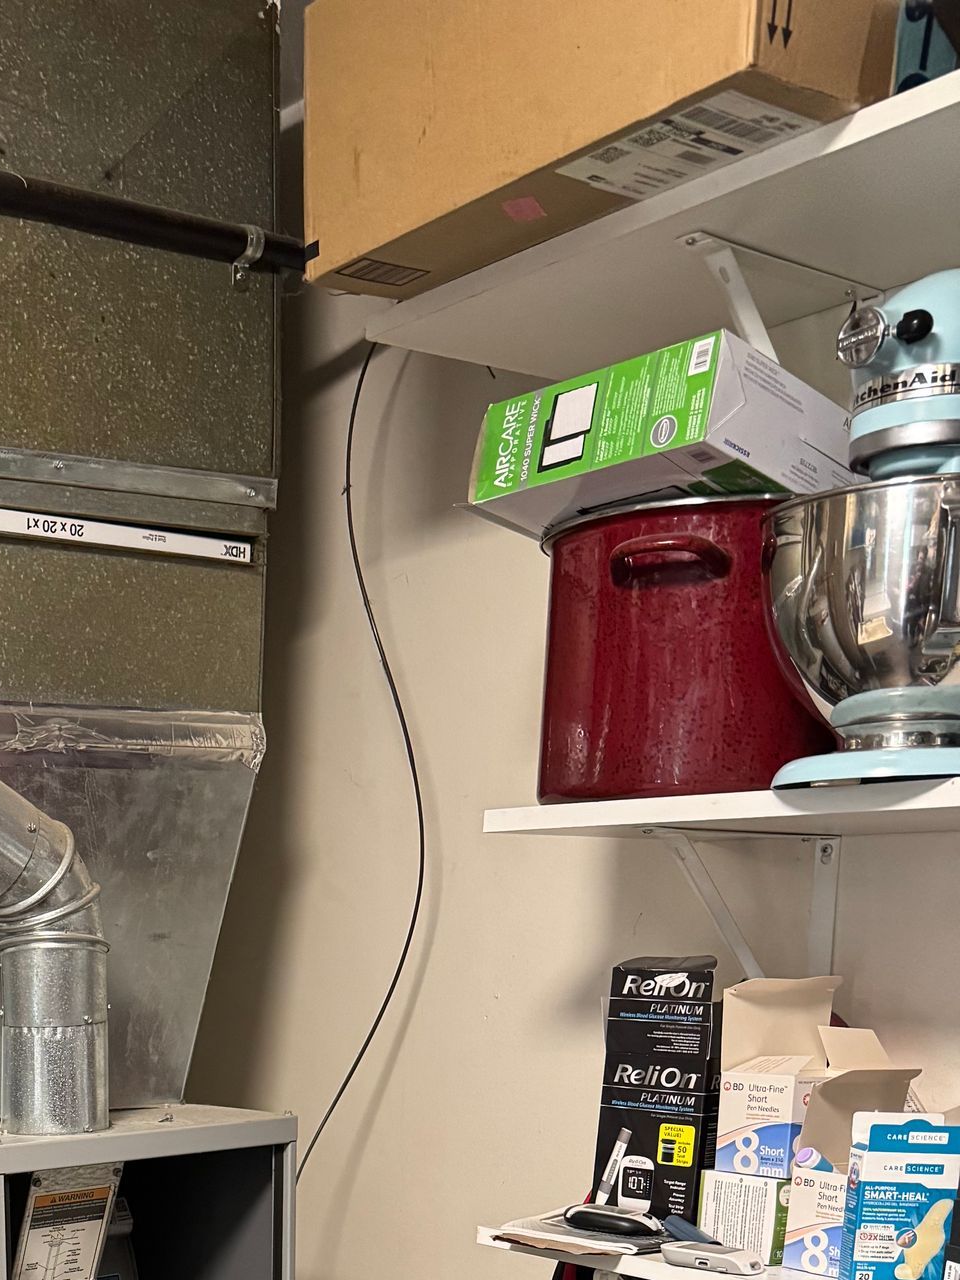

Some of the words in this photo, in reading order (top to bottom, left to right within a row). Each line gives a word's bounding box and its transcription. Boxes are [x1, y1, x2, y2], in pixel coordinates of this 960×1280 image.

[494, 402, 521, 487] AIRCARE
[506, 400, 527, 487] EVAPORATIVE
[524, 424, 535, 457] SUPER
[521, 460, 529, 480] 1040
[42, 520, 57, 534] 20
[60, 522, 67, 532] x
[69, 523, 84, 537] 20
[223, 544, 246, 558] HDX
[650, 1004, 703, 1015] PLATINUM
[614, 1064, 699, 1089] ReliOn
[641, 1093, 695, 1106] PLATINUM
[748, 1094, 767, 1103] Short
[733, 1130, 759, 1173] 8
[760, 1146, 784, 1156] Short
[628, 1177, 643, 1189] 107
[58, 1192, 94, 1201] WARNING
[818, 1192, 838, 1203] Short
[864, 1191, 927, 1201] SMART-HEAL
[801, 1229, 828, 1274] 8
